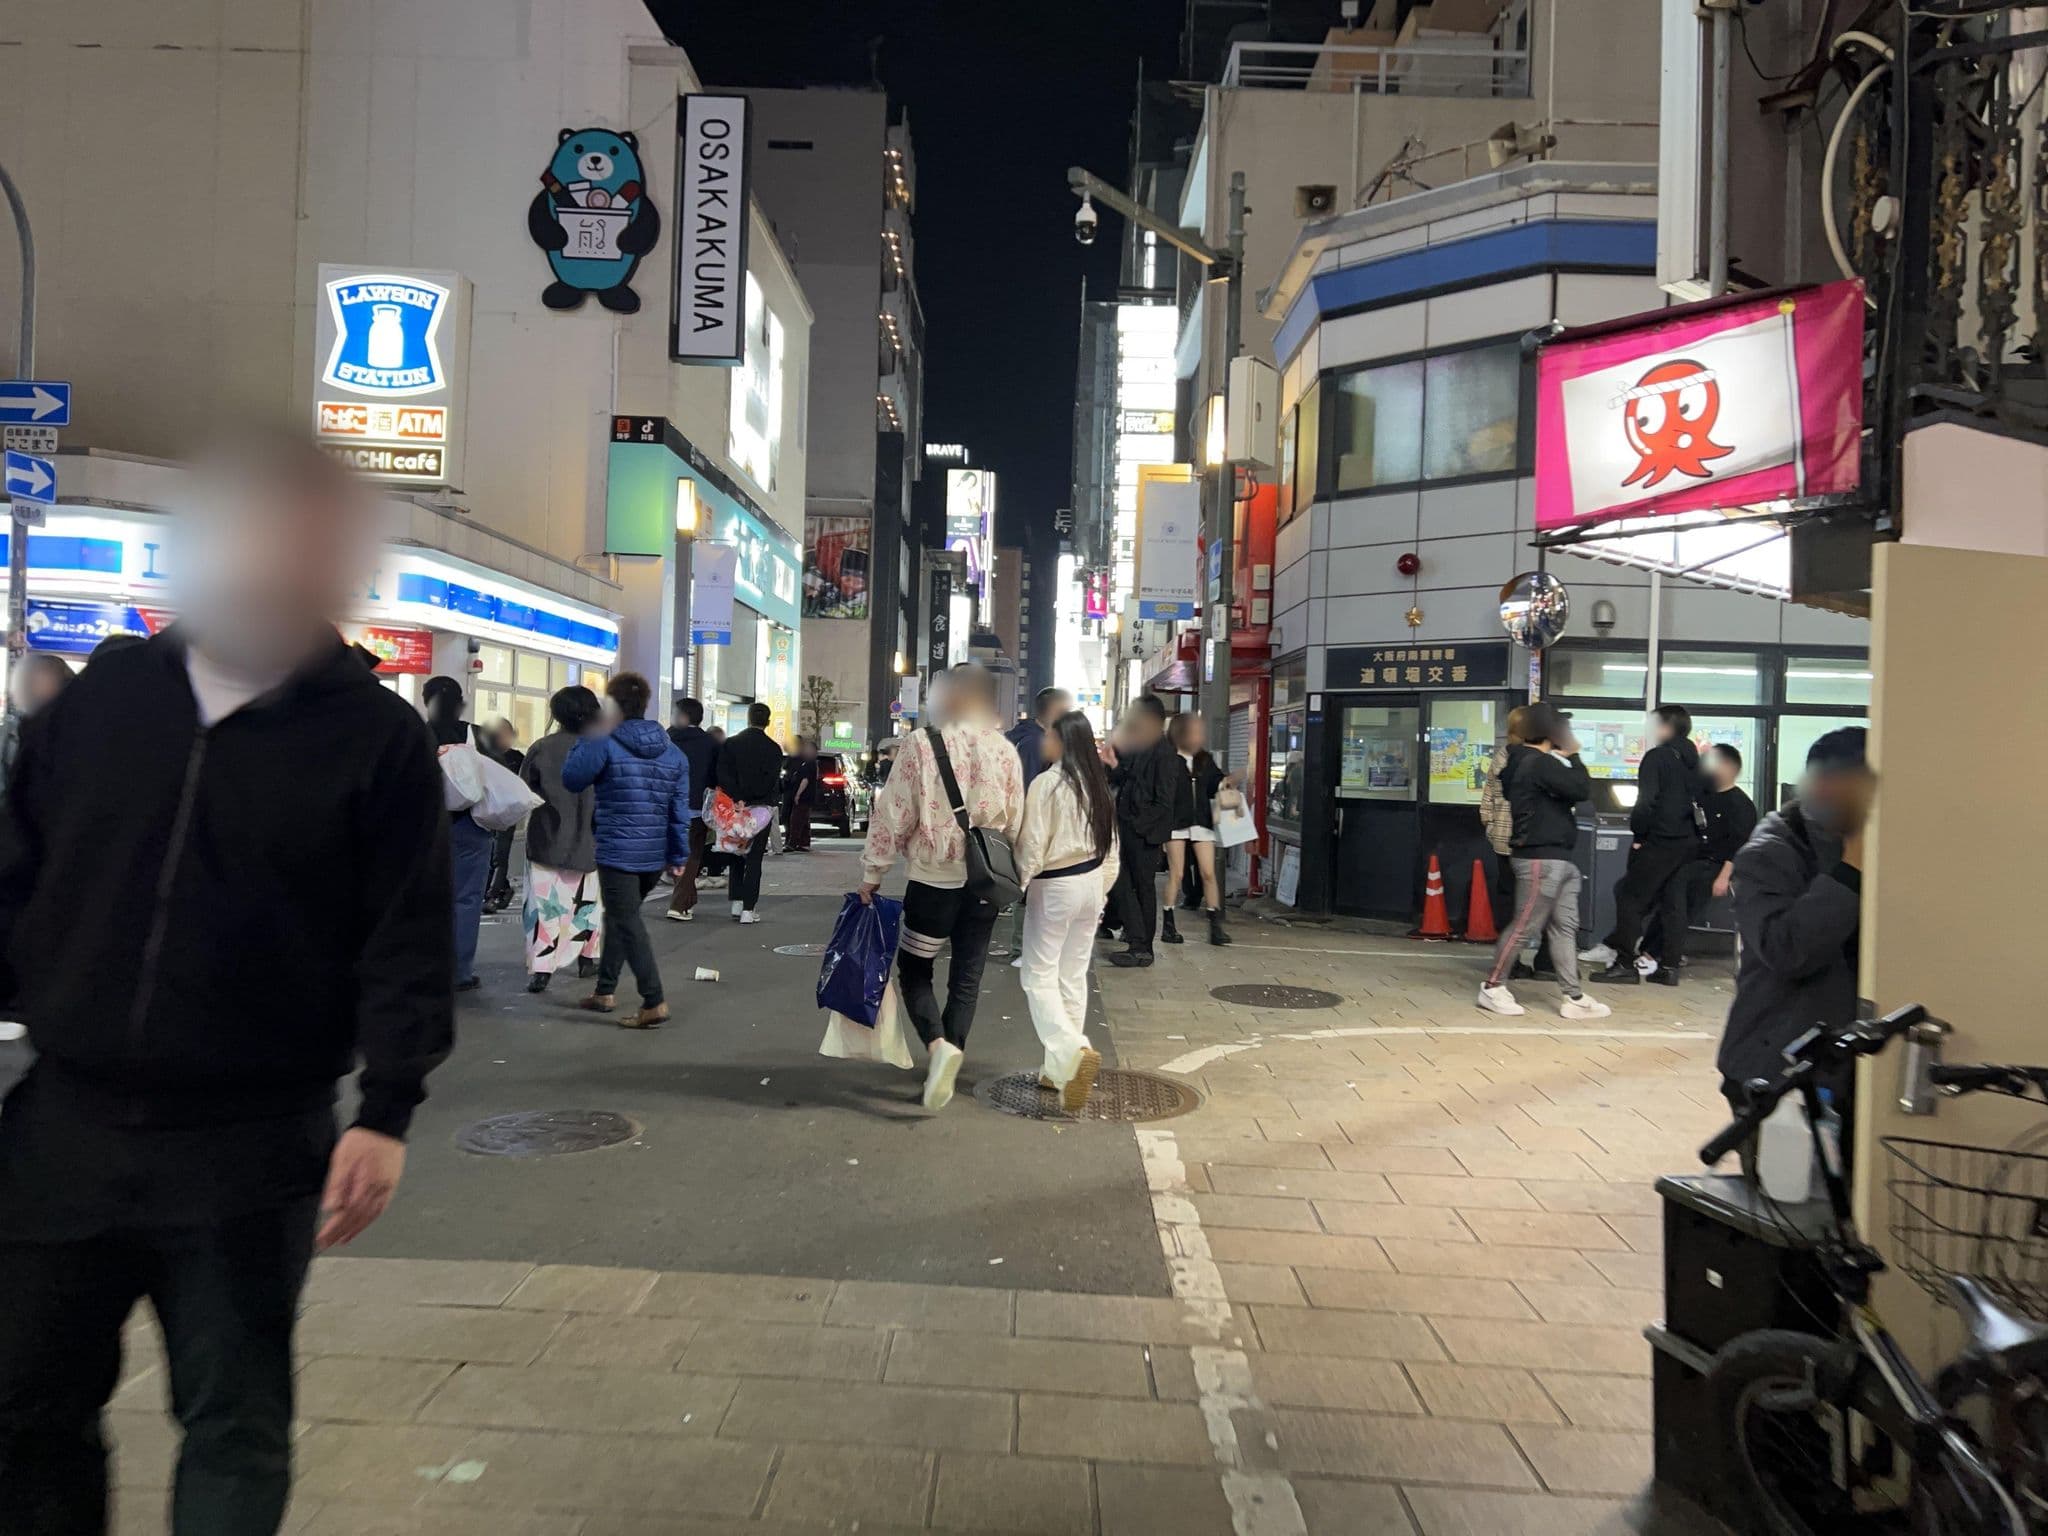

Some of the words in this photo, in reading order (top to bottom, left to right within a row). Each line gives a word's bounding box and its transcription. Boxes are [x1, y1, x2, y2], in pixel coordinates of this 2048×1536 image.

[693, 118, 730, 333] OSAKAKUMA
[339, 285, 435, 311] LAWSON
[338, 362, 431, 387] STATION
[322, 407, 367, 430] たばこ
[398, 411, 442, 435] ATM
[6, 438, 55, 451] ここまで
[926, 444, 963, 456] BRAVE
[393, 453, 438, 471] café
[1373, 649, 1455, 662] 大阪府南警察署
[1360, 665, 1467, 684] 道頓堀交番
[824, 739, 850, 750] Holiday
[851, 740, 862, 749] Inn
